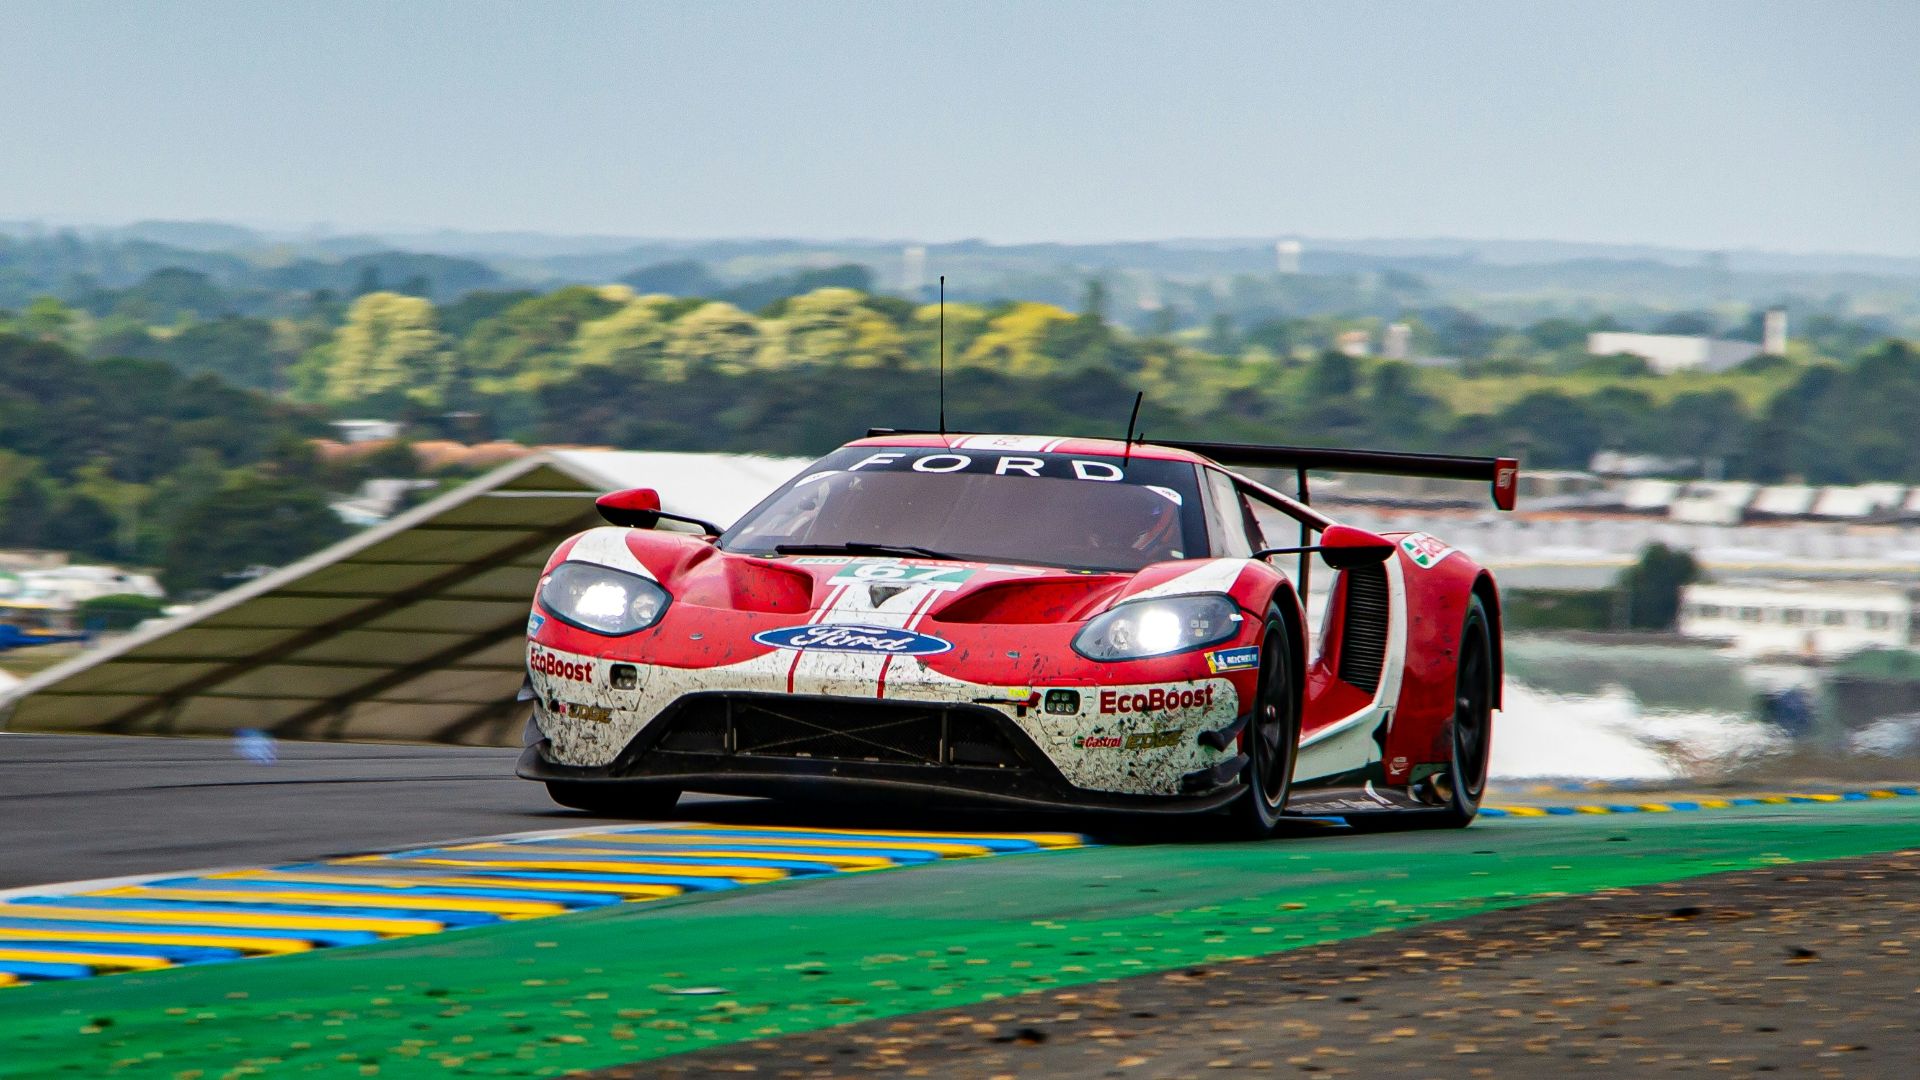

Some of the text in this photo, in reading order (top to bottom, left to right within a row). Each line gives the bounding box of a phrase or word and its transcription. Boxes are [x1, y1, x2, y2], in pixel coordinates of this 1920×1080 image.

[848, 453, 1124, 481] FORD
[854, 564, 963, 579] 67
[790, 626, 915, 650] Ford
[530, 647, 592, 684] EcoBoost
[1100, 685, 1213, 714] EcoBoost
[1085, 736, 1122, 748] Castrol
